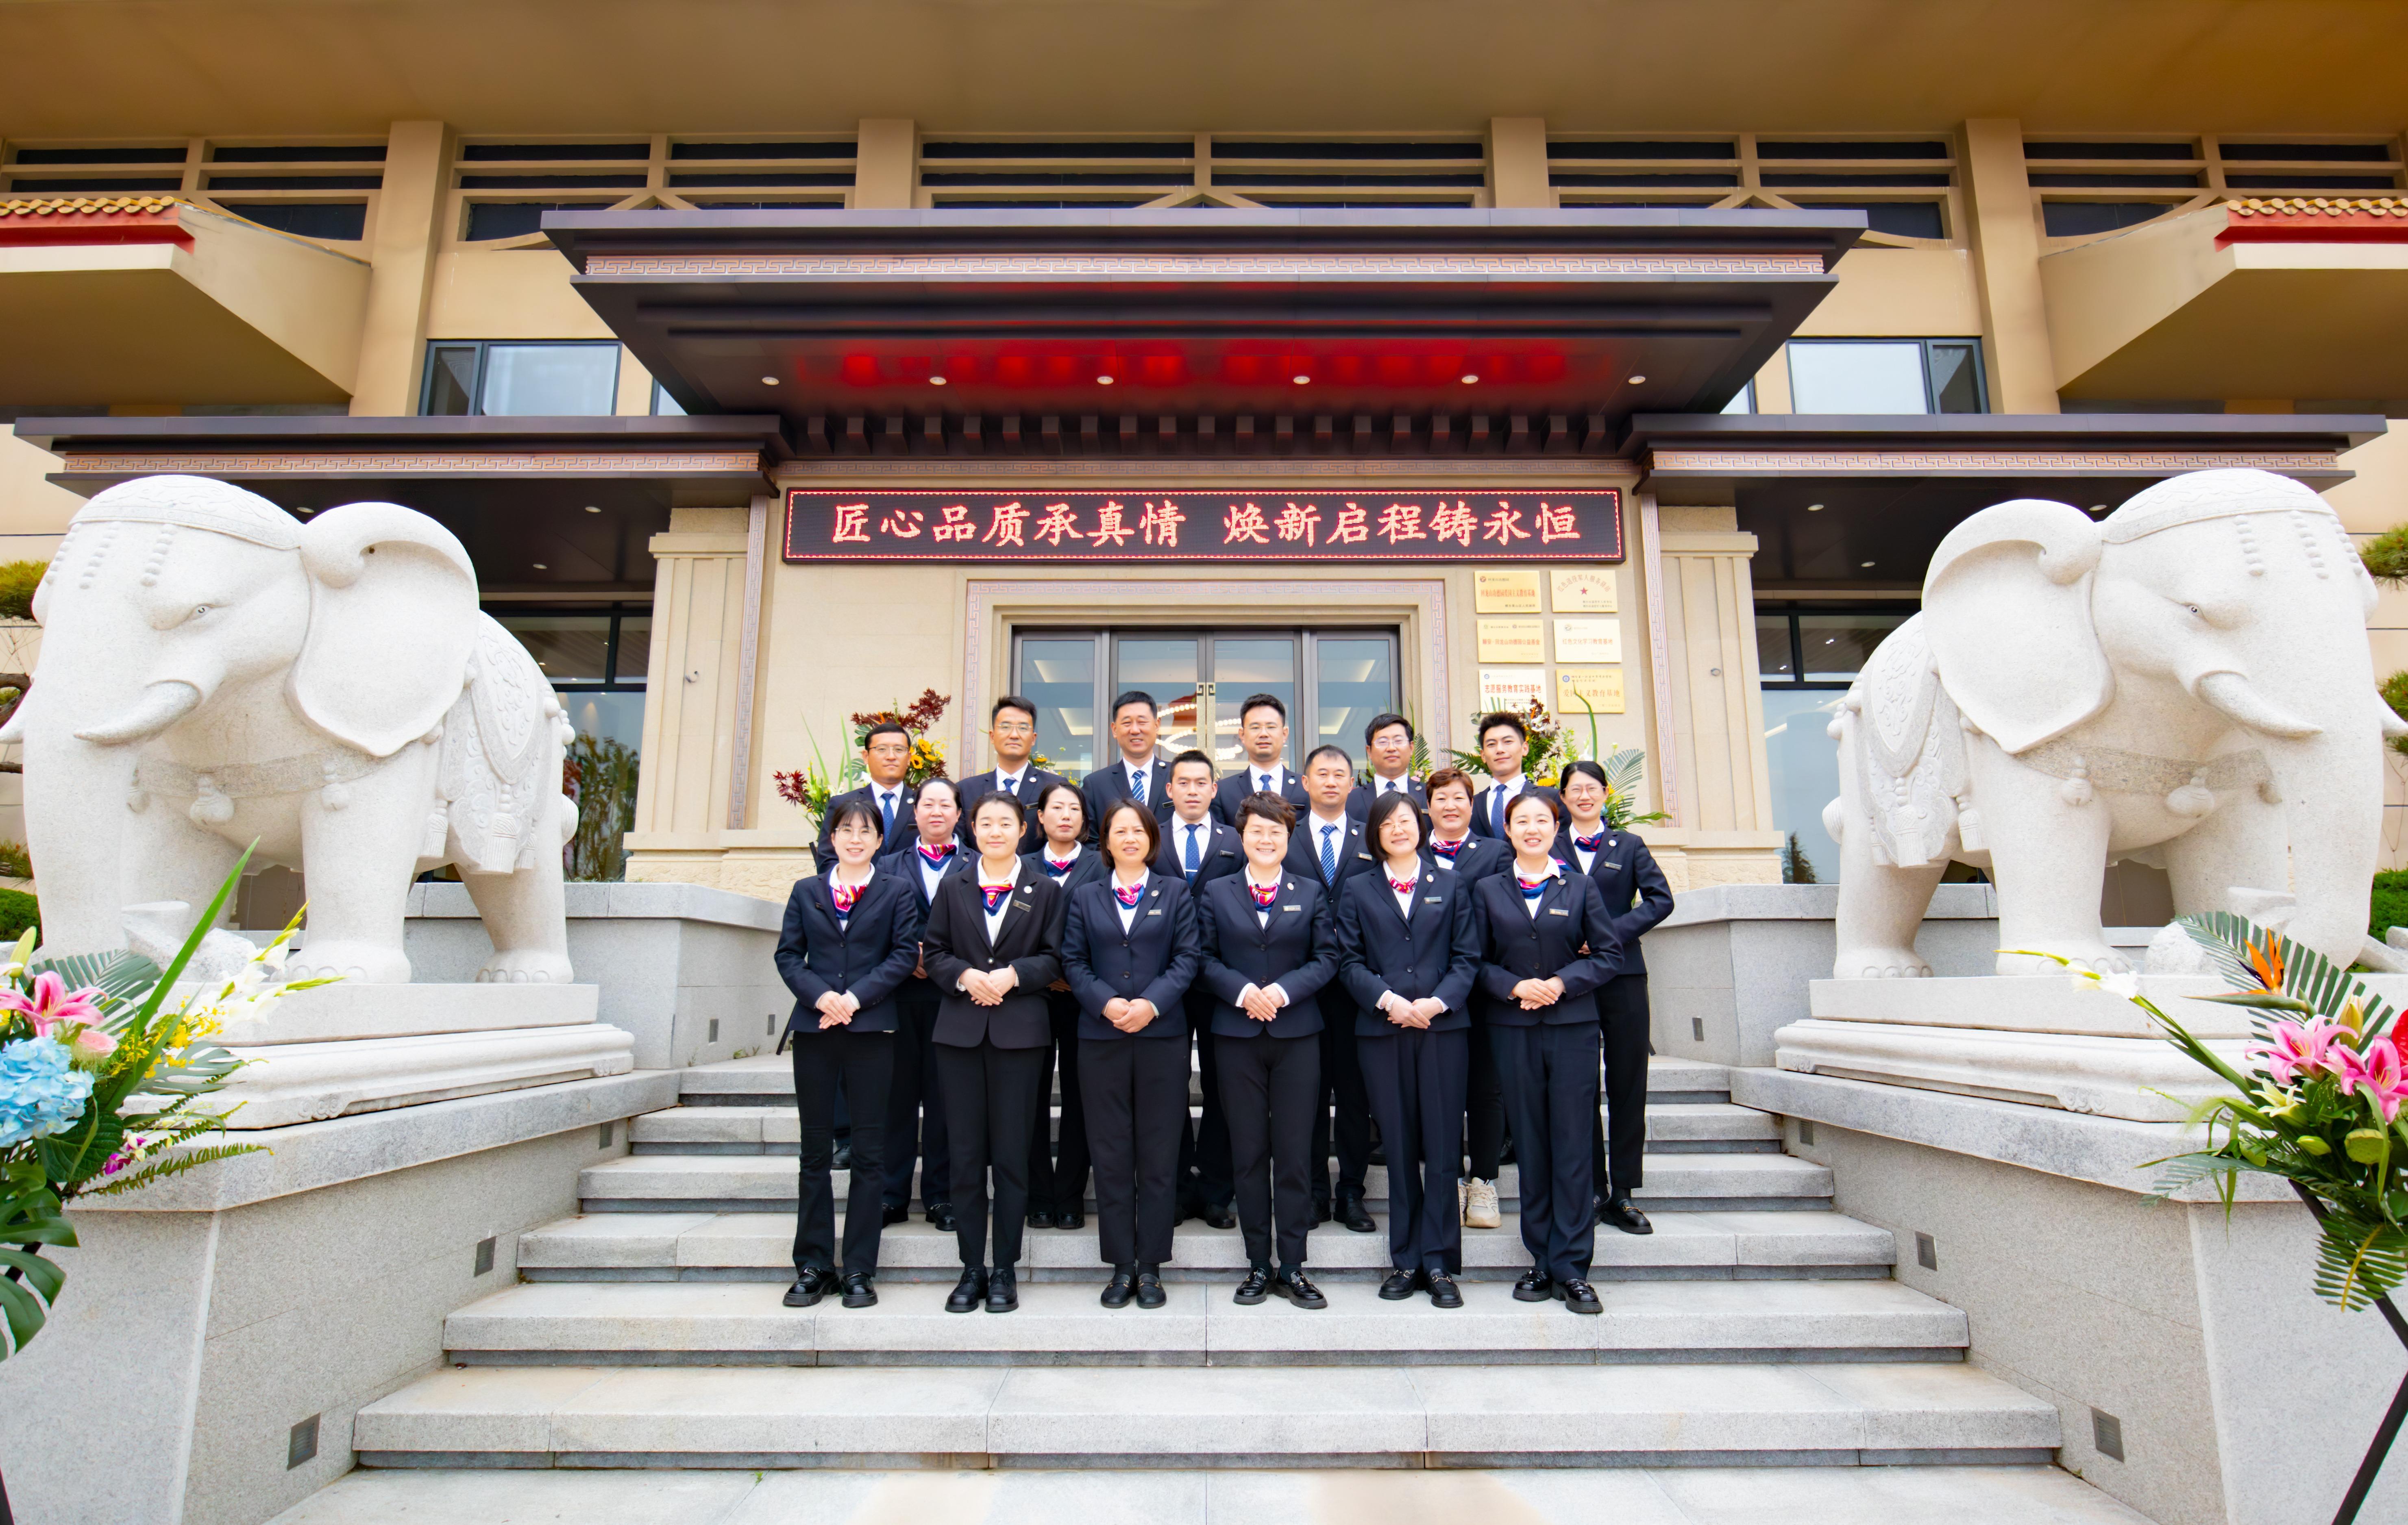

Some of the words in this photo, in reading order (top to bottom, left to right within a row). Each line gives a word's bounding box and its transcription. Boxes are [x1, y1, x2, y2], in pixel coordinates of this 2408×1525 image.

[832, 500, 1187, 548] 匠心品质承真情
[1223, 501, 1581, 547] 焕新启程铸永恒
[1485, 684, 1541, 693] 志愿服务教育实践基地
